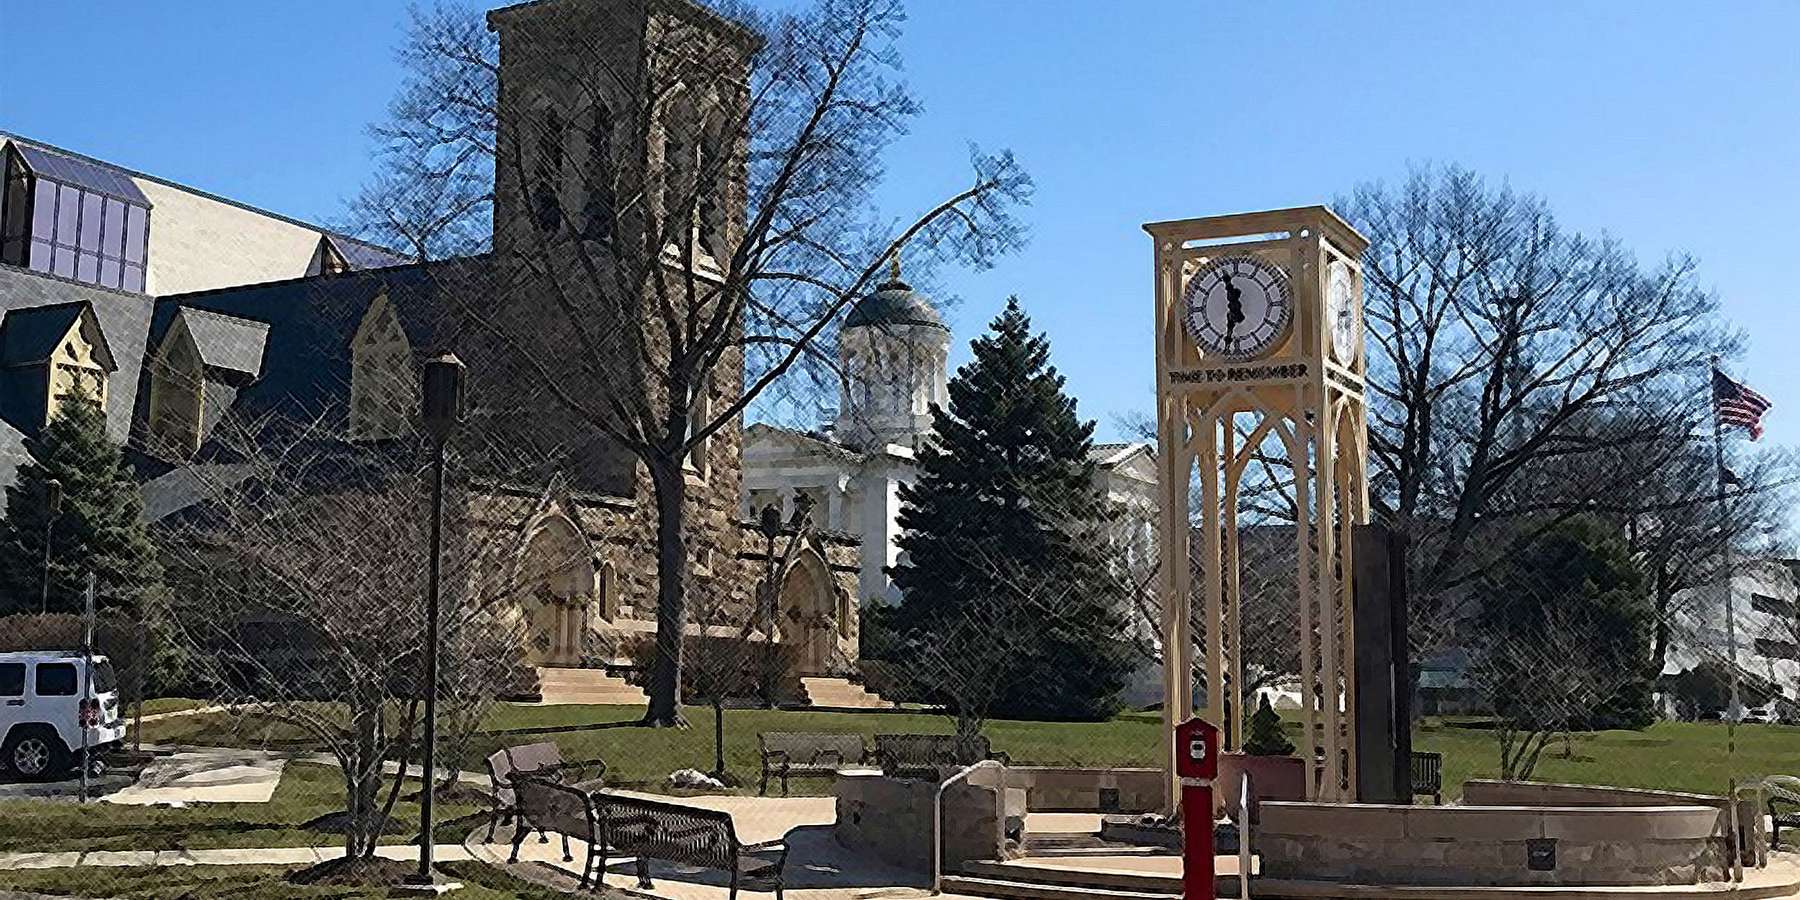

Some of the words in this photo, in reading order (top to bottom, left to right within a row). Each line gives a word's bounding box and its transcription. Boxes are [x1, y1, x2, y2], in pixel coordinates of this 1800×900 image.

[1169, 371, 1202, 384] TIME
[1205, 369, 1226, 383] TO
[1227, 364, 1309, 382] REMEMBER
